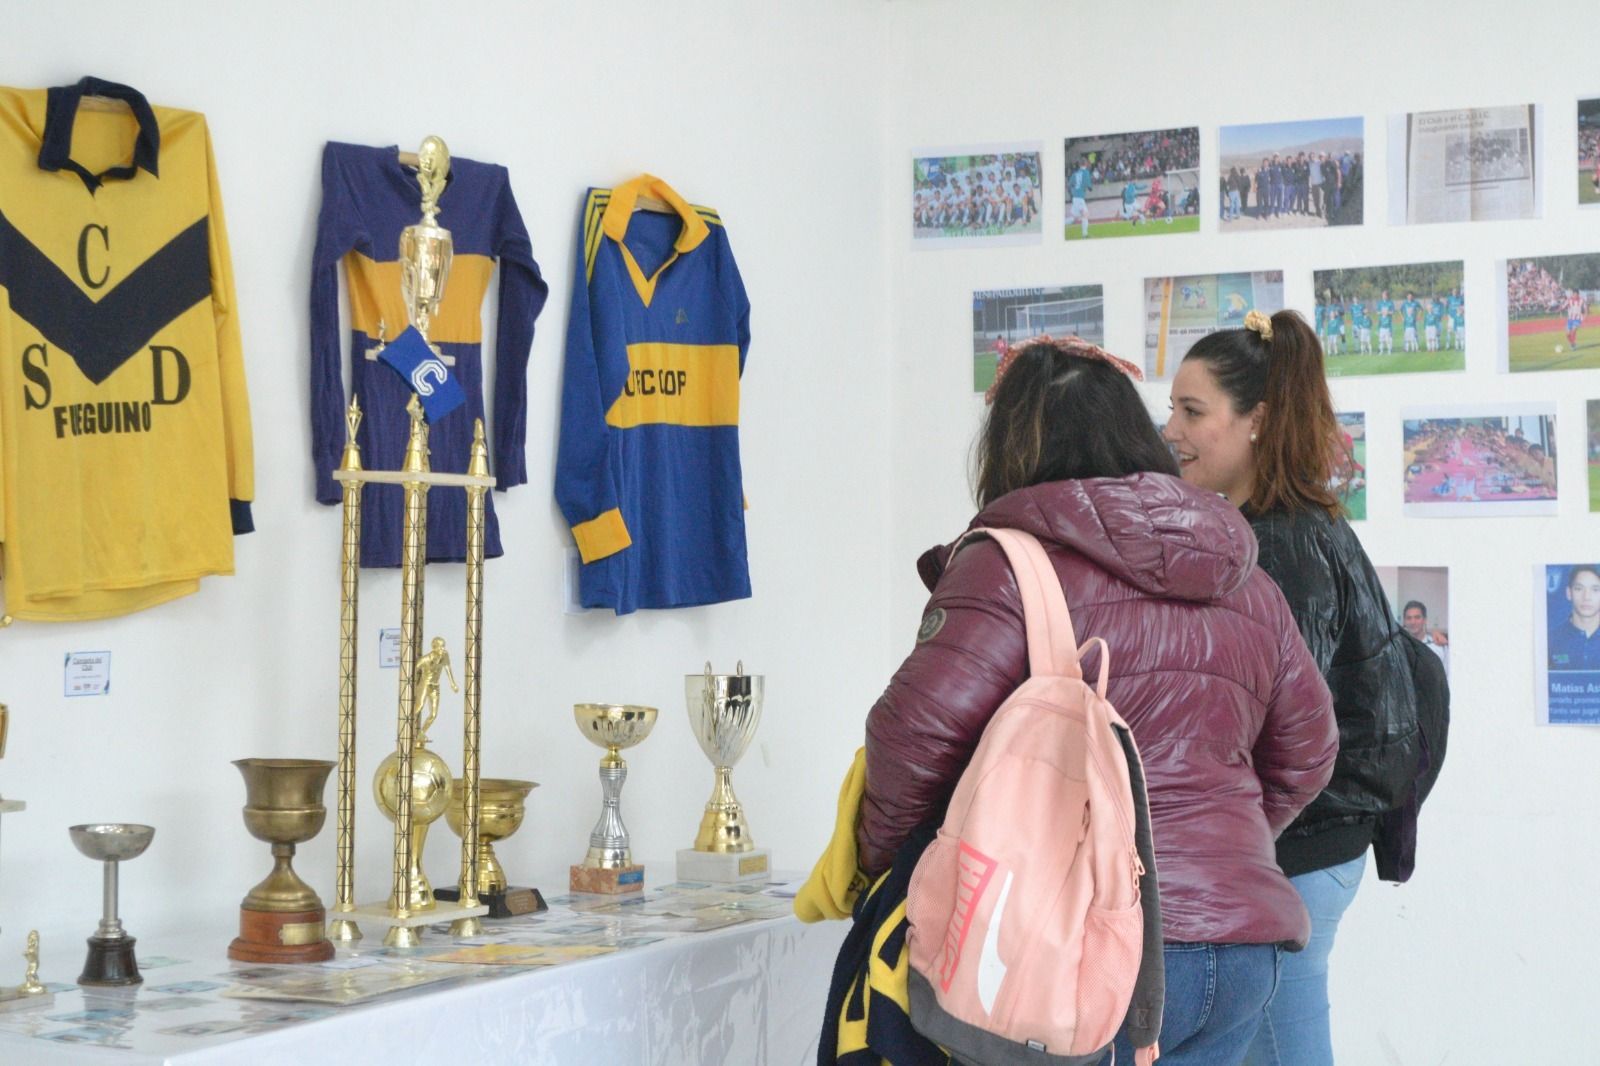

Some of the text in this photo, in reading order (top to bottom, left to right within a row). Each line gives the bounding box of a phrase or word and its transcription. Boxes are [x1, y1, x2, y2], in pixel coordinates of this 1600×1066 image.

[77, 223, 111, 289] C
[21, 343, 191, 411] S D
[411, 359, 448, 397] C
